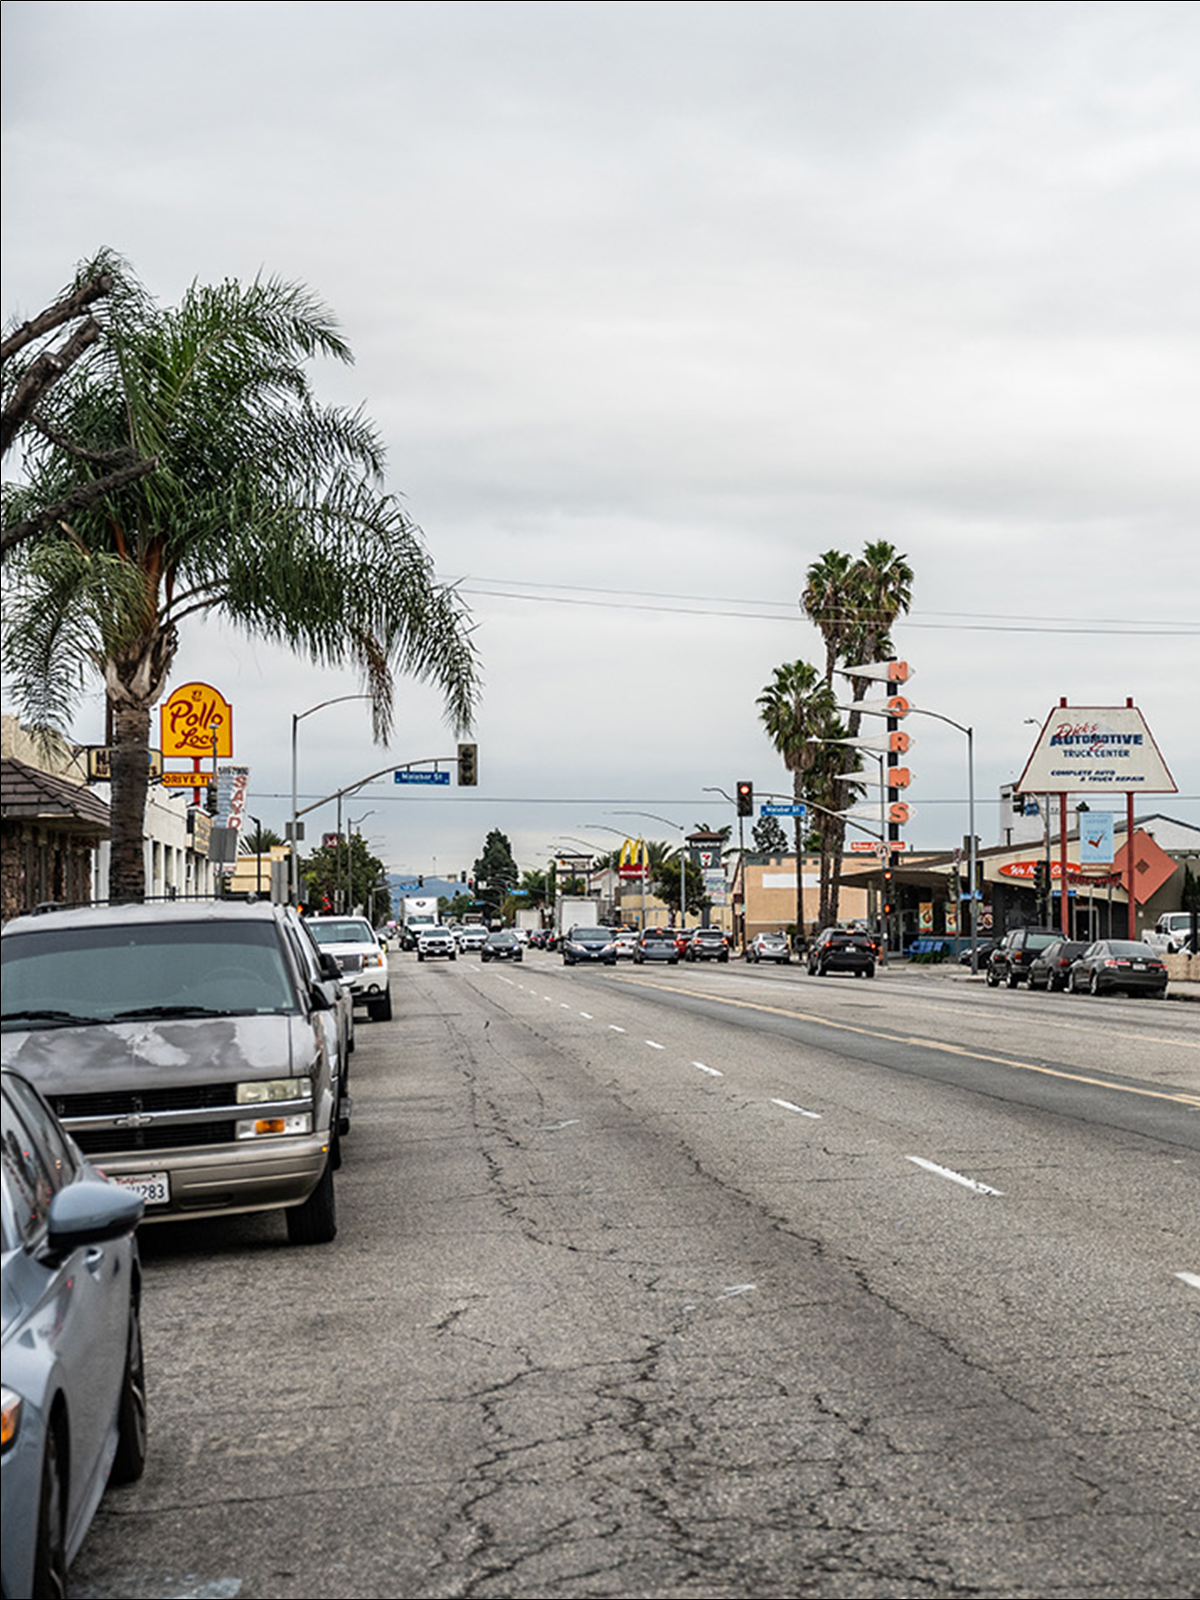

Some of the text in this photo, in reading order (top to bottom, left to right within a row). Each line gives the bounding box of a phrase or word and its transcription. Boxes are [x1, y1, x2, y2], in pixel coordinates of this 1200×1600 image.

[169, 700, 224, 733] Pollo
[175, 727, 218, 749] Loco
[888, 661, 910, 821] NORMS
[1049, 734, 1143, 746] AUTOMOTIVE
[1062, 750, 1130, 758] TRUCK CENTER
[163, 775, 198, 785] DRIVE
